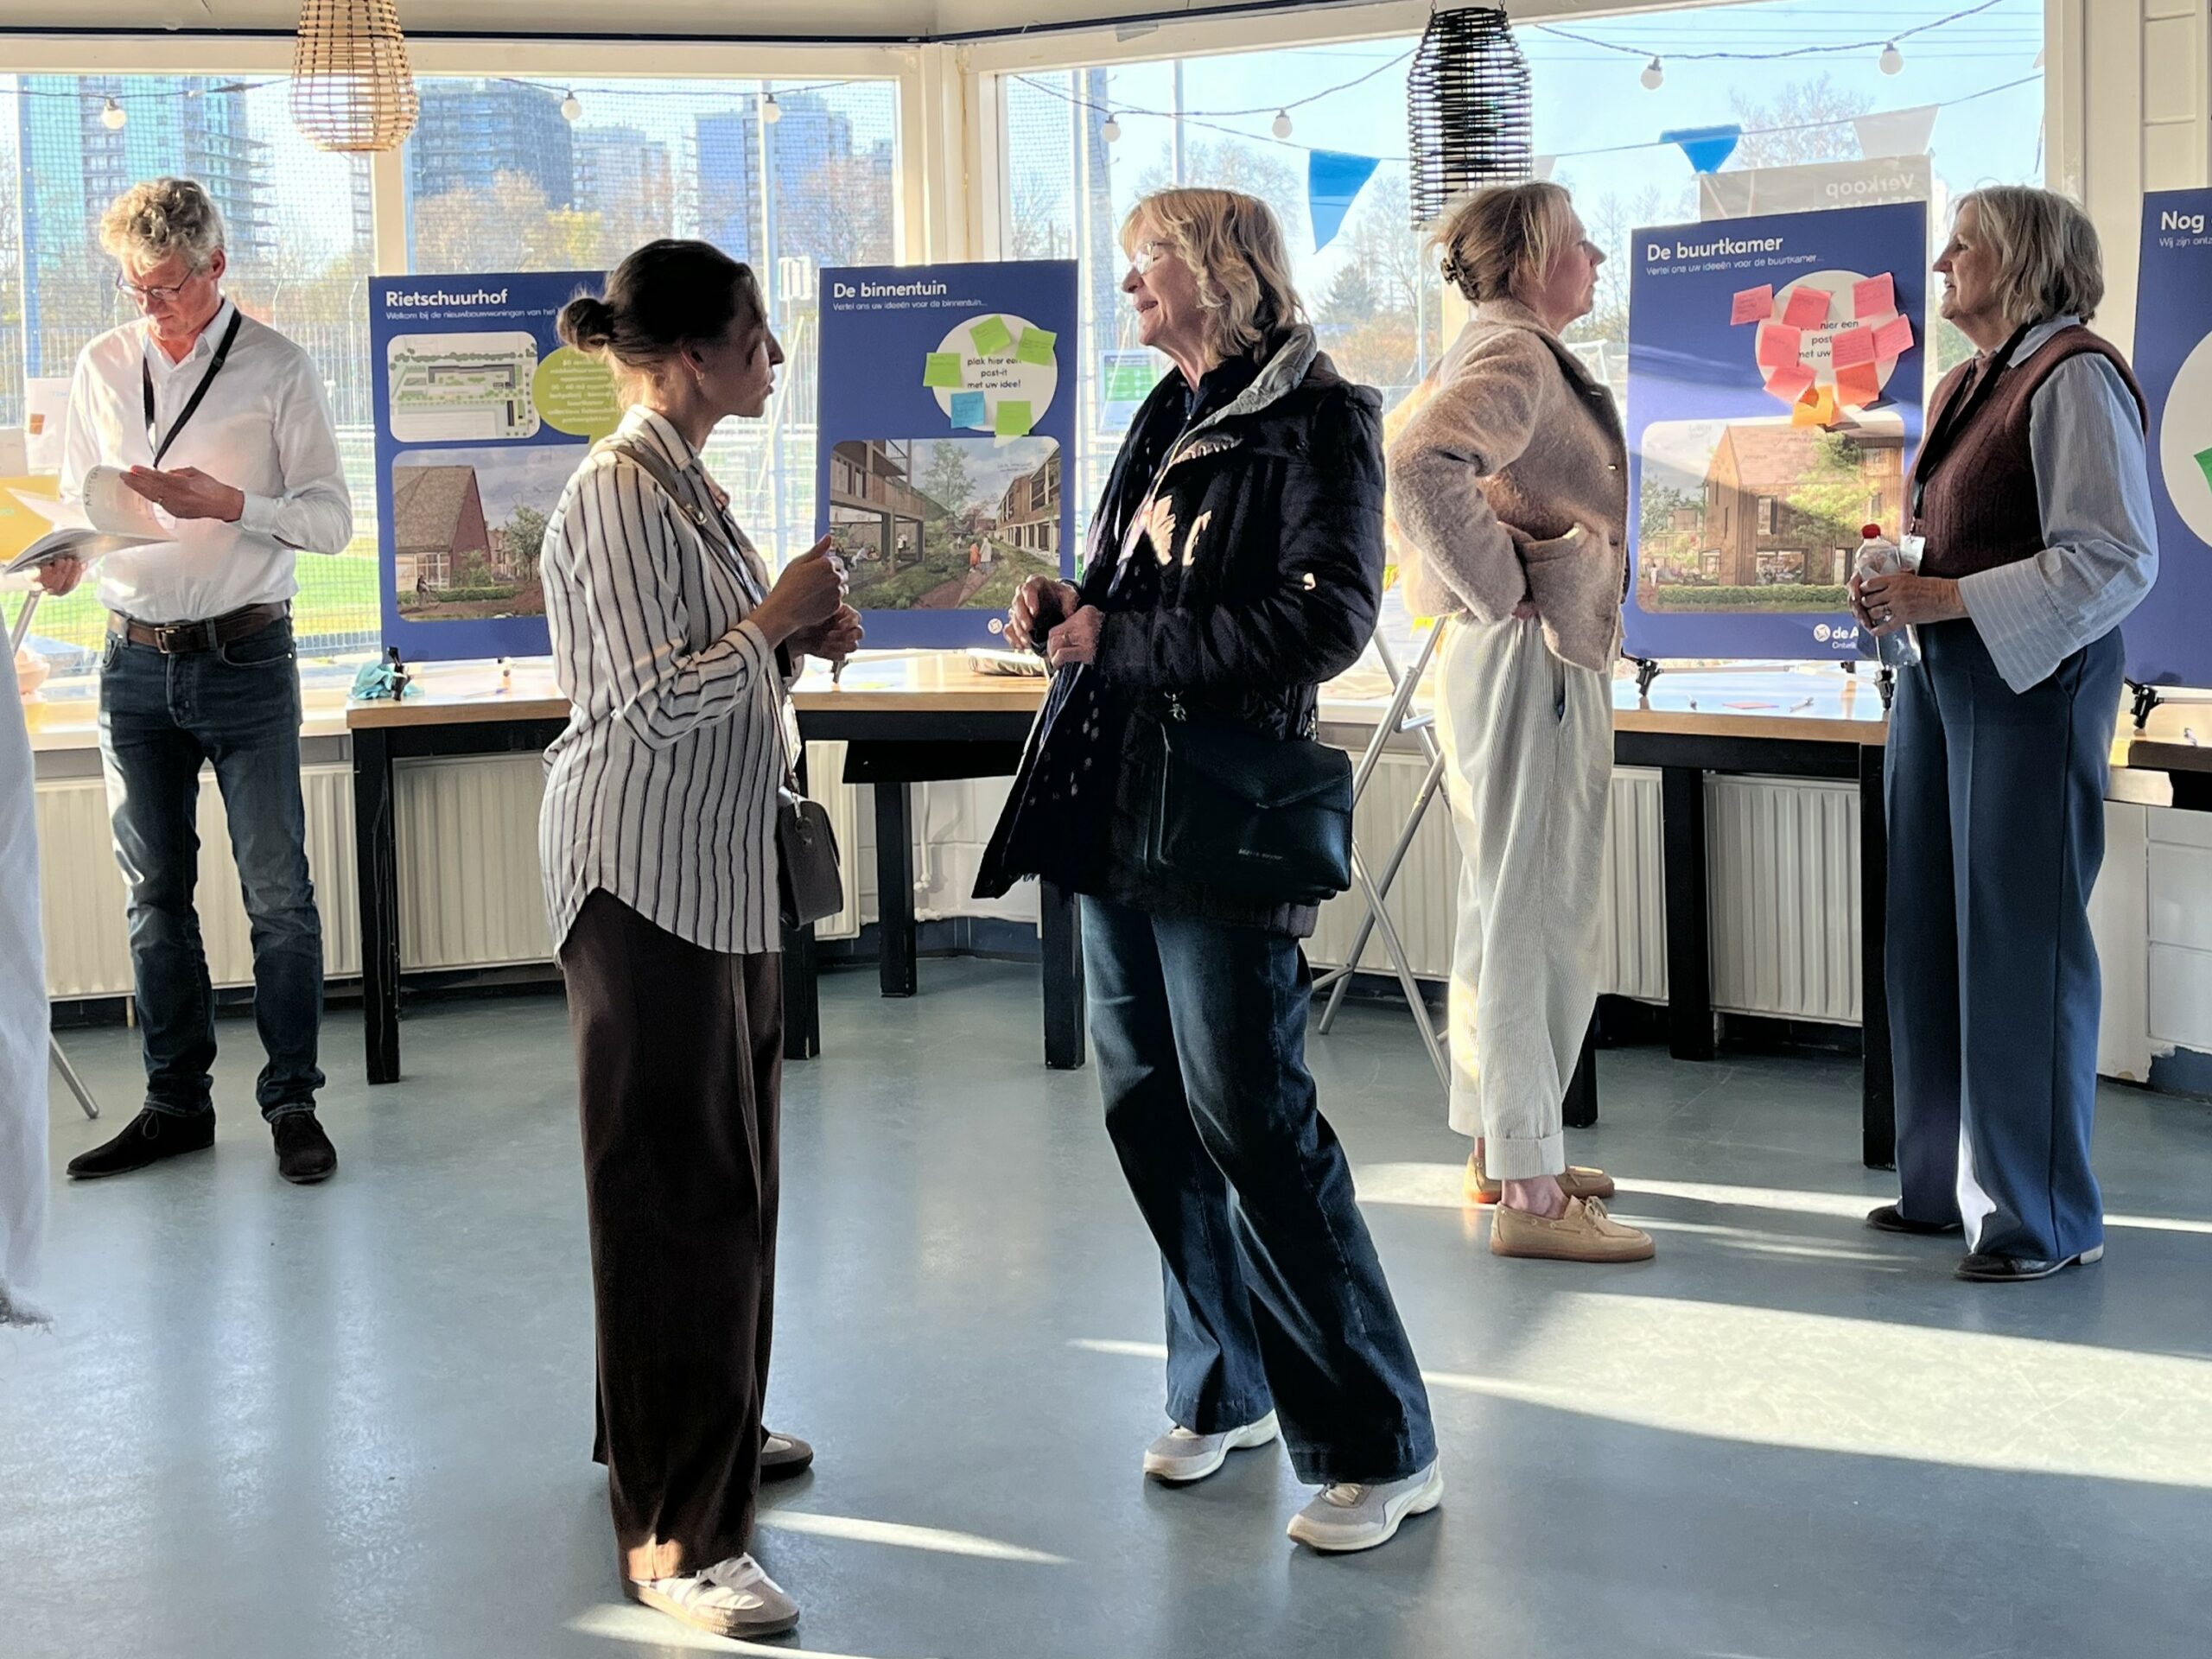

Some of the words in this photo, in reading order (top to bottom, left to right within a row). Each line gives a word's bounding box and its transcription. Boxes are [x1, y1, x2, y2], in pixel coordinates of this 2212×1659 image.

[2161, 210, 2205, 233] Nog
[1647, 244, 1671, 262] De
[1676, 237, 1783, 259] buurtkamer
[1646, 265, 1669, 276] Vertel
[1671, 264, 1687, 274] ons
[1688, 264, 1701, 272] uw
[1733, 260, 1751, 269] voor
[1754, 257, 1765, 267] de
[833, 283, 856, 298] De
[861, 279, 947, 297] binnentuin
[385, 288, 508, 307] Rietschuurhof
[832, 302, 855, 311] Vertel
[930, 299, 940, 308] de
[385, 311, 417, 321] Welkom
[419, 310, 429, 321] bij
[430, 310, 442, 319] de
[1811, 335, 1833, 346] post
[967, 357, 985, 366] plak
[981, 369, 1007, 378] post-it
[1000, 379, 1021, 388] idee!
